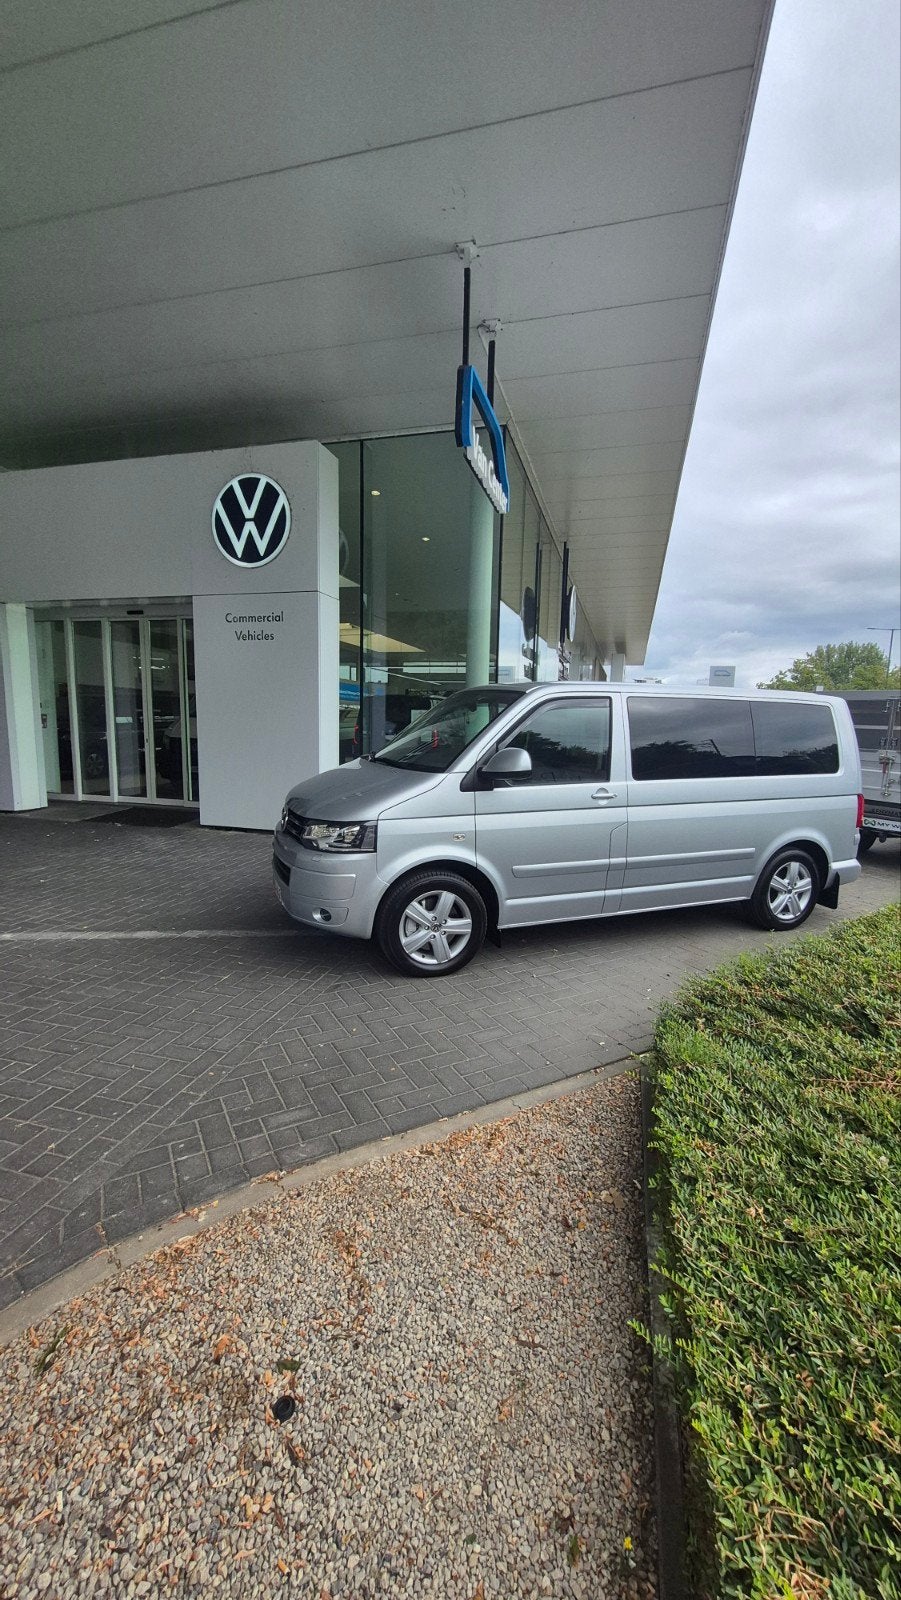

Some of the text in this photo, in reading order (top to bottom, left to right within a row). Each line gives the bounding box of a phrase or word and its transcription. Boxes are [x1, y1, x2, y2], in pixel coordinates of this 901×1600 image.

[471, 424, 487, 478] Van
[213, 475, 289, 565] VW
[225, 610, 284, 623] Commercial
[234, 629, 275, 641] Vehicles
